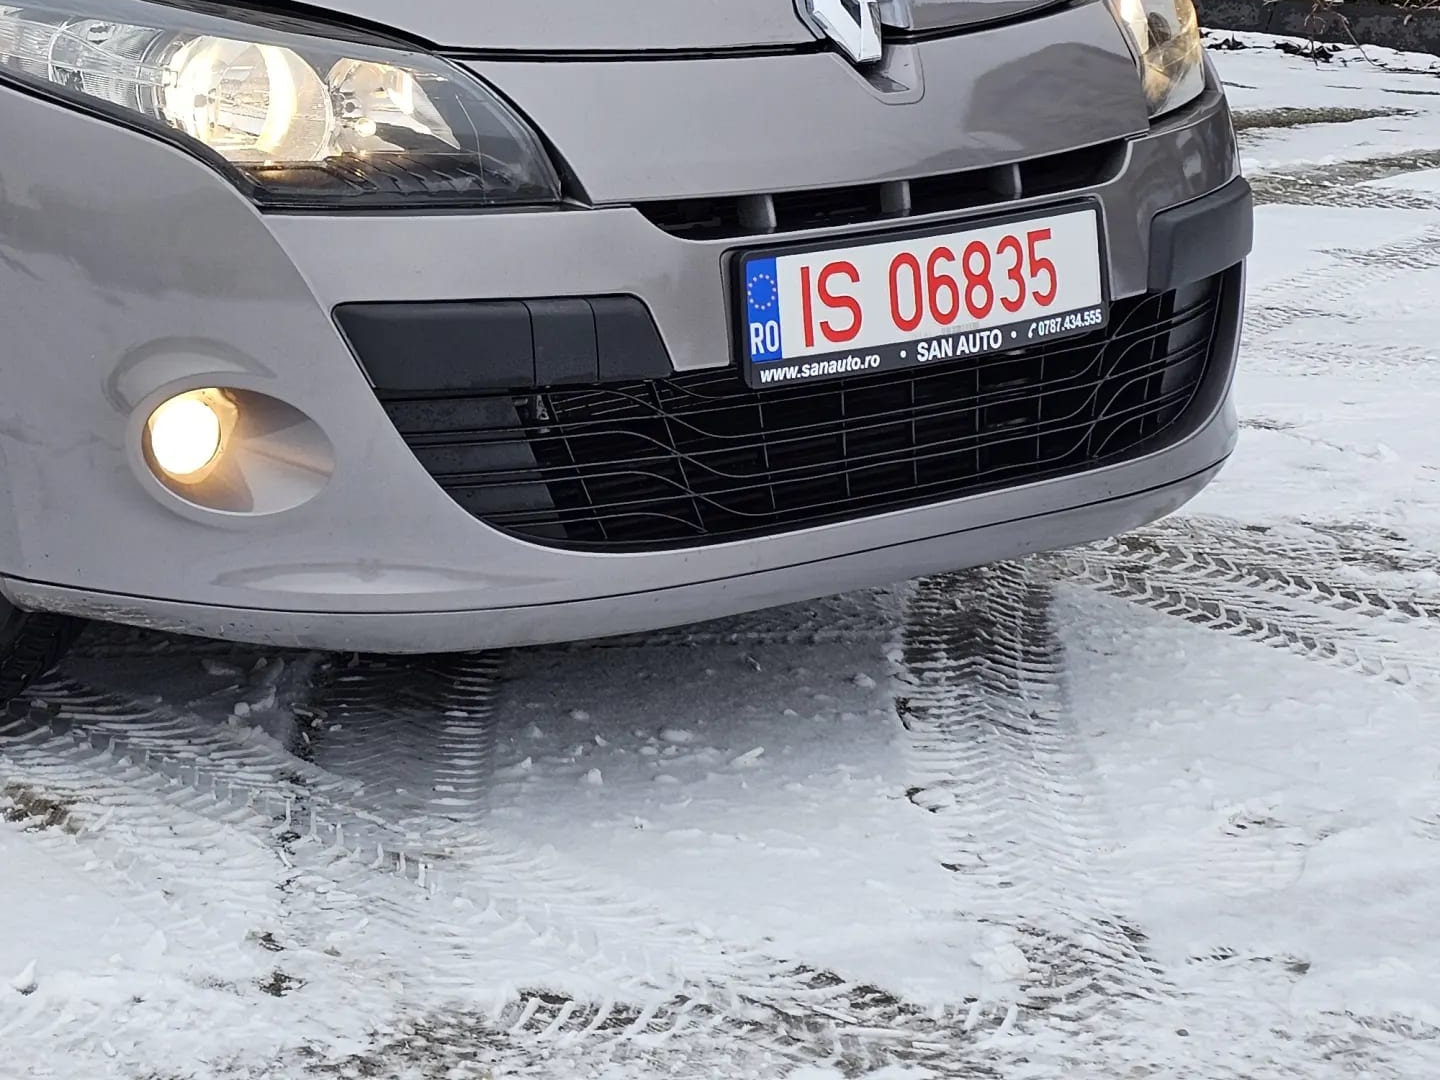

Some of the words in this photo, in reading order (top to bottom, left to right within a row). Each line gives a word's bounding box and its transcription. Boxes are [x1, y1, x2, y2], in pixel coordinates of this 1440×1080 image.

[800, 261, 863, 348] IS
[889, 228, 1058, 332] 06835
[750, 320, 779, 355] RO
[760, 354, 881, 383] www.sanauto.ro
[917, 337, 953, 362] SAN
[957, 328, 1003, 356] AUTO
[1038, 309, 1103, 336] 0787.434.555
